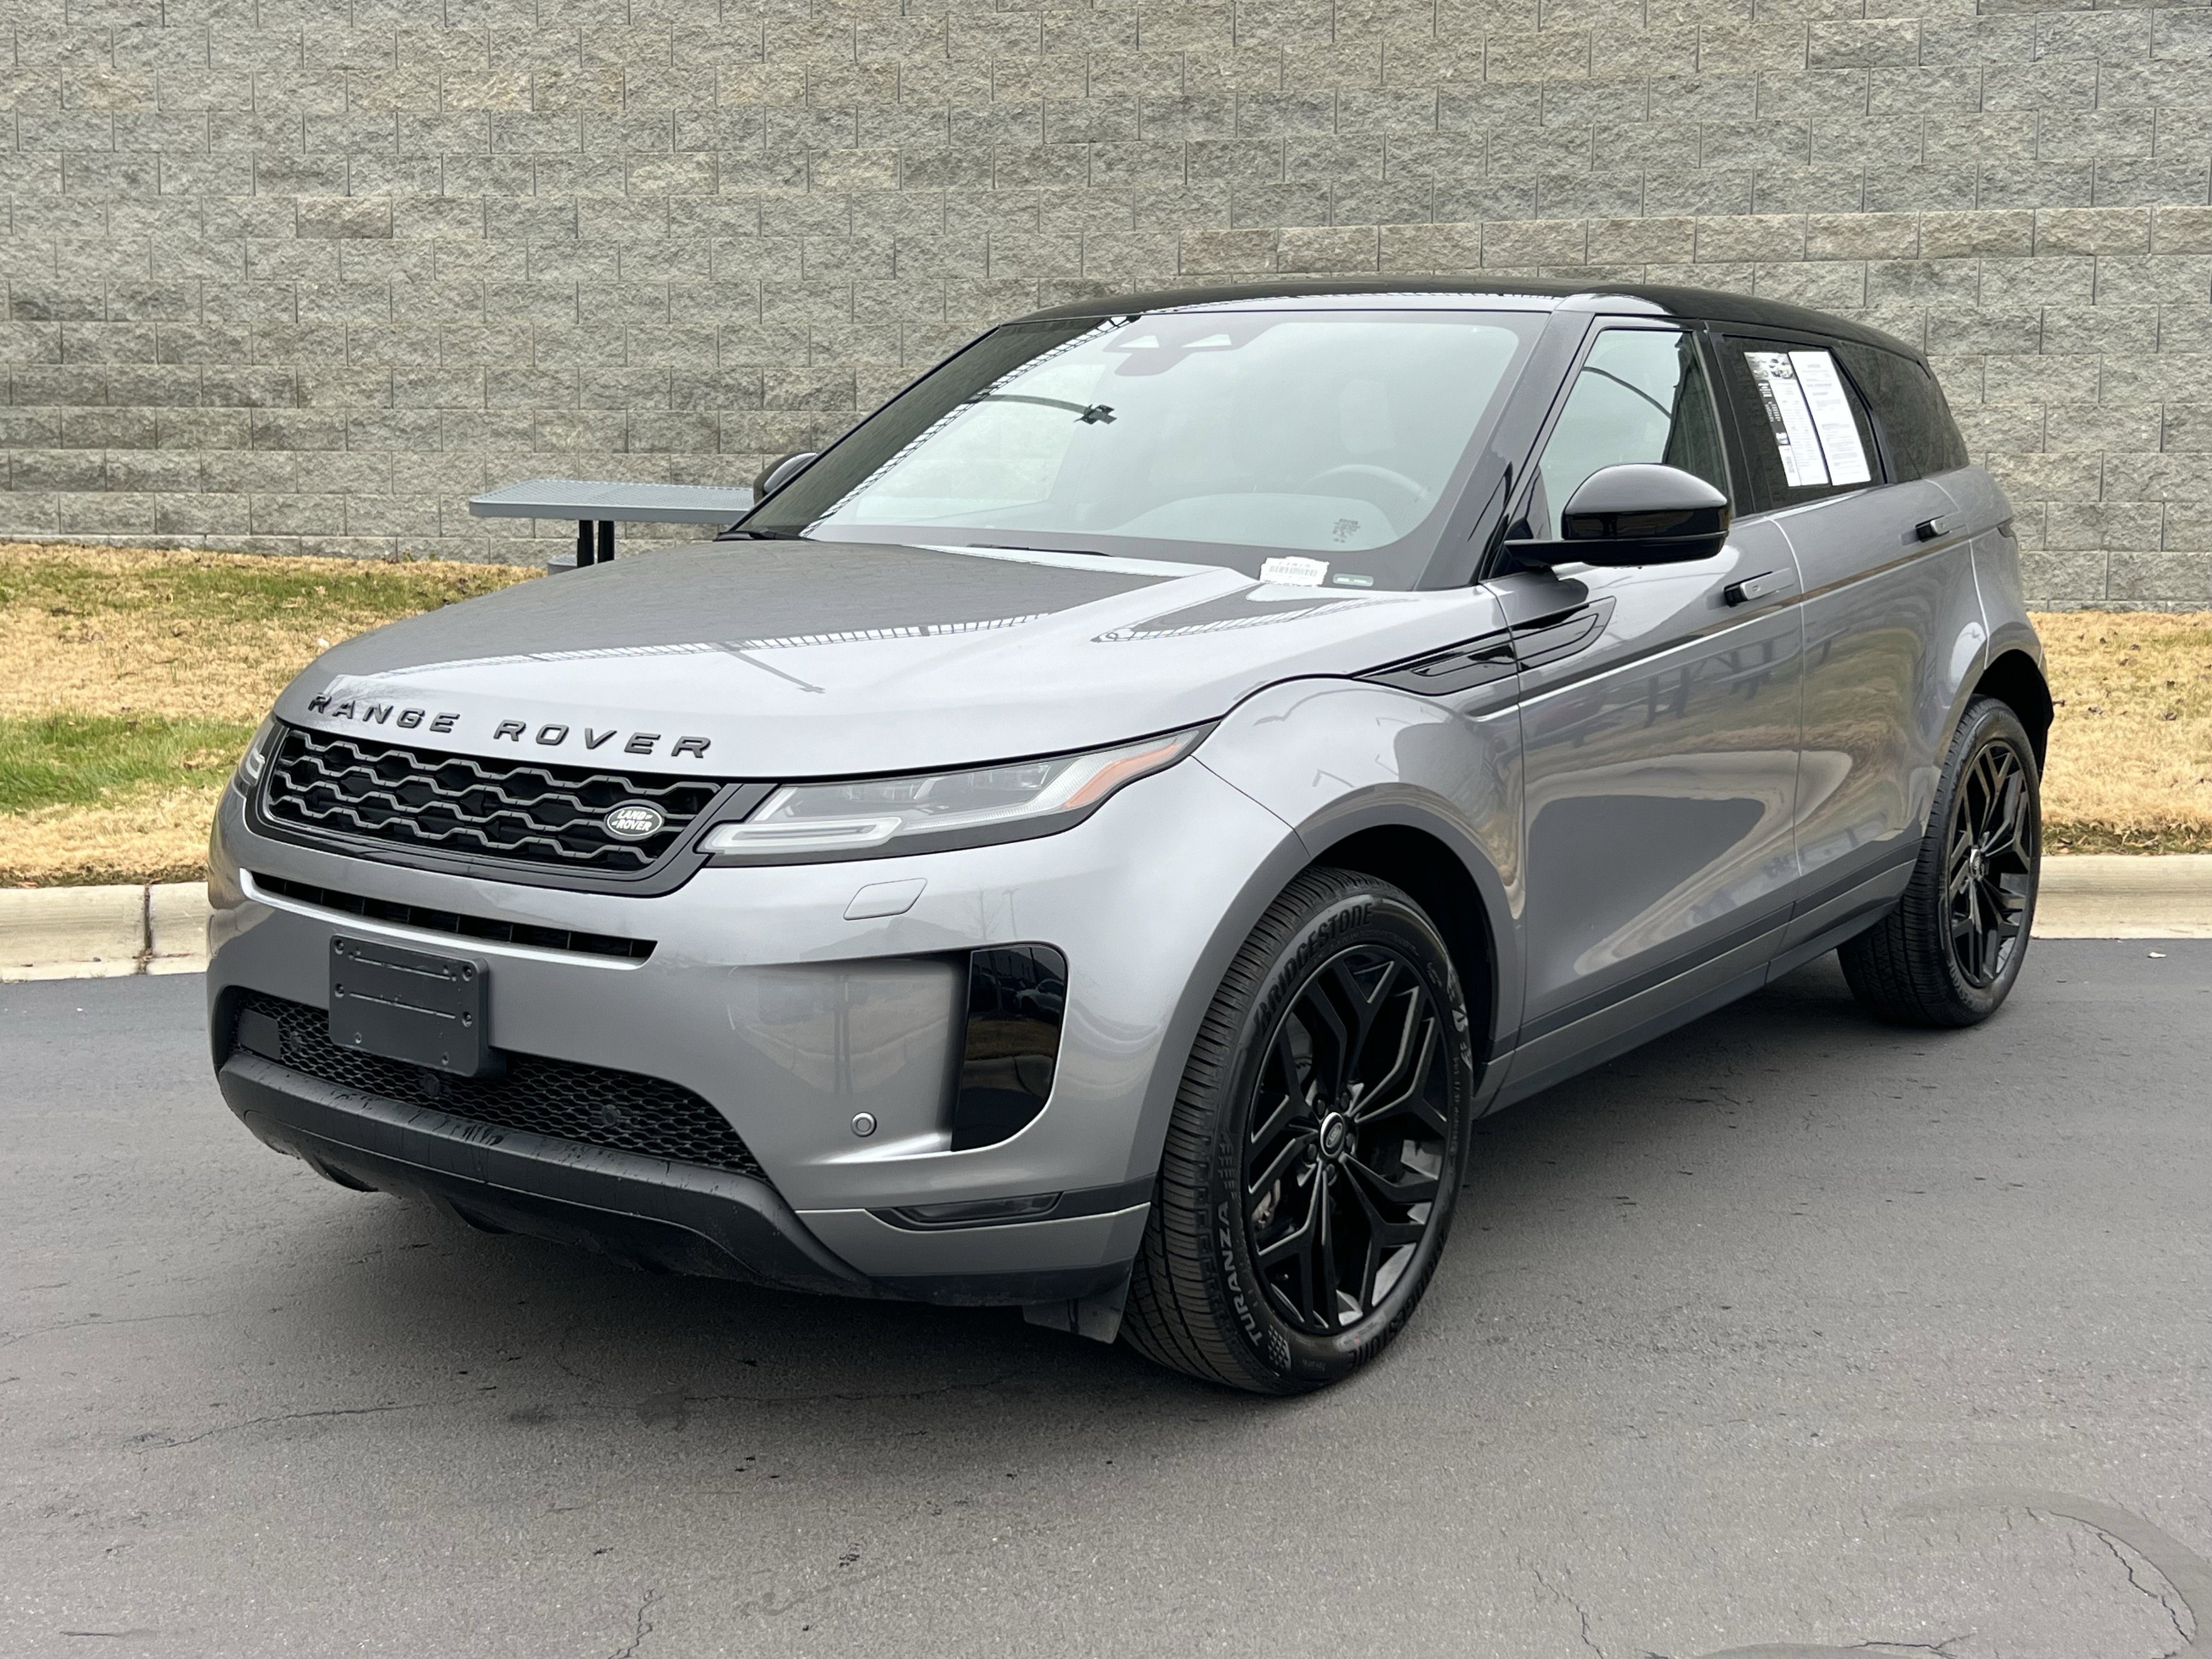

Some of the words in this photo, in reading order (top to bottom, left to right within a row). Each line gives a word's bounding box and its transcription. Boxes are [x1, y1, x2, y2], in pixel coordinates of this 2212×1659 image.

[307, 692, 460, 733] RANGE
[493, 719, 712, 759] ROVER
[616, 820, 652, 831] ROVER
[617, 810, 647, 820] LAND
[1254, 902, 1374, 1036] BRIDGESTONE
[1217, 1200, 1263, 1347] TURANZA
